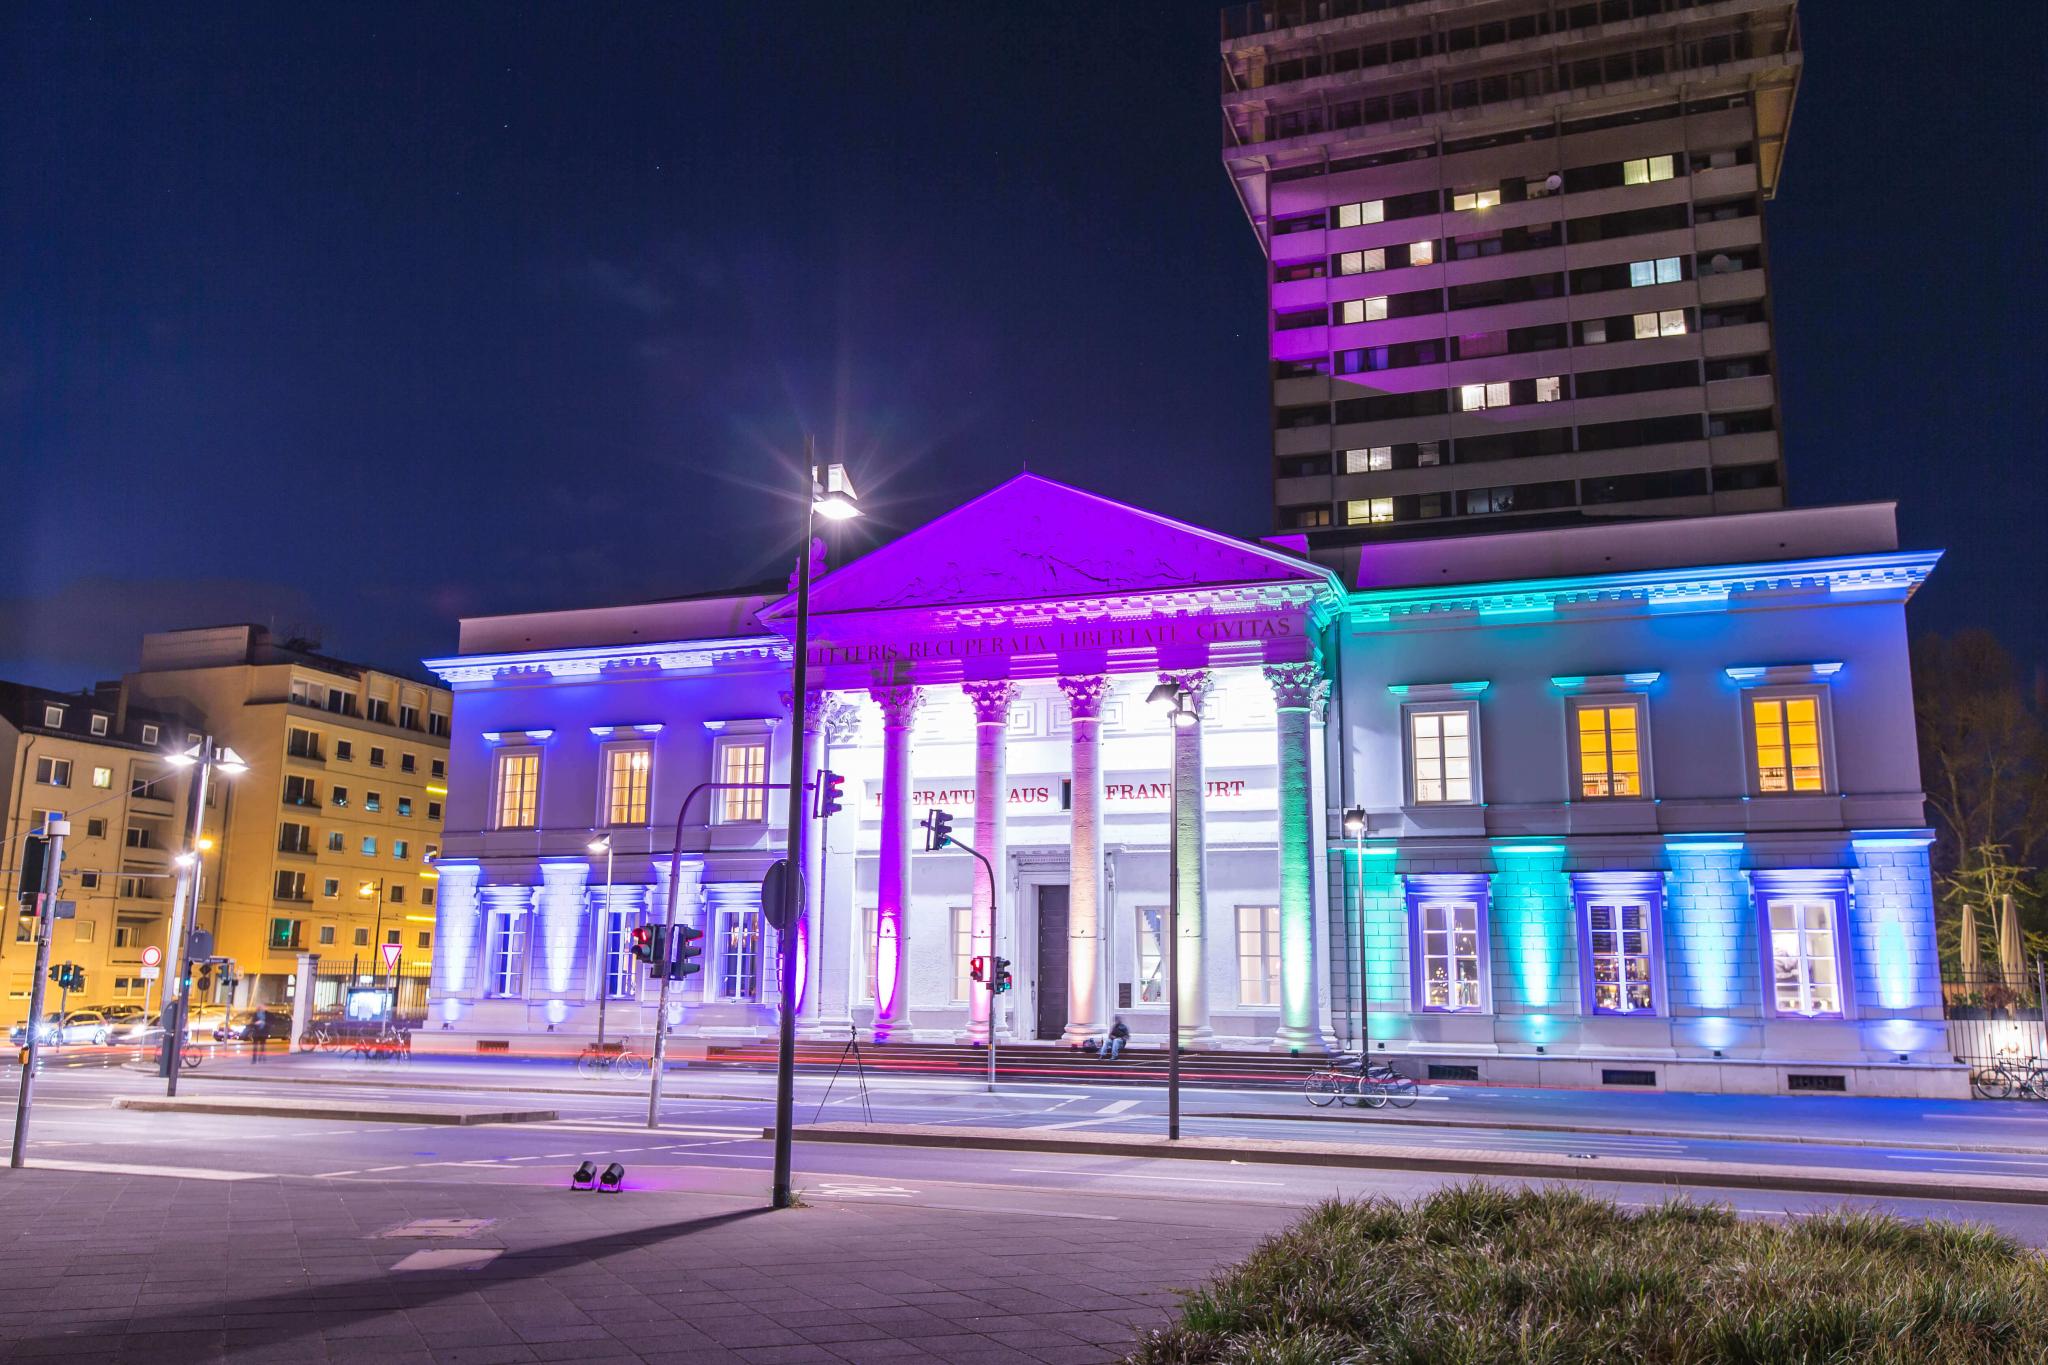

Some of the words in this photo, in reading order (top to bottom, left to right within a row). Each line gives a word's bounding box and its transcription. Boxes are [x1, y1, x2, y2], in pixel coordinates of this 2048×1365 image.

[1196, 617, 1291, 641] CIVITAS
[875, 787, 1049, 808] LERATUAUS
[1105, 780, 1245, 801] FRANURT
